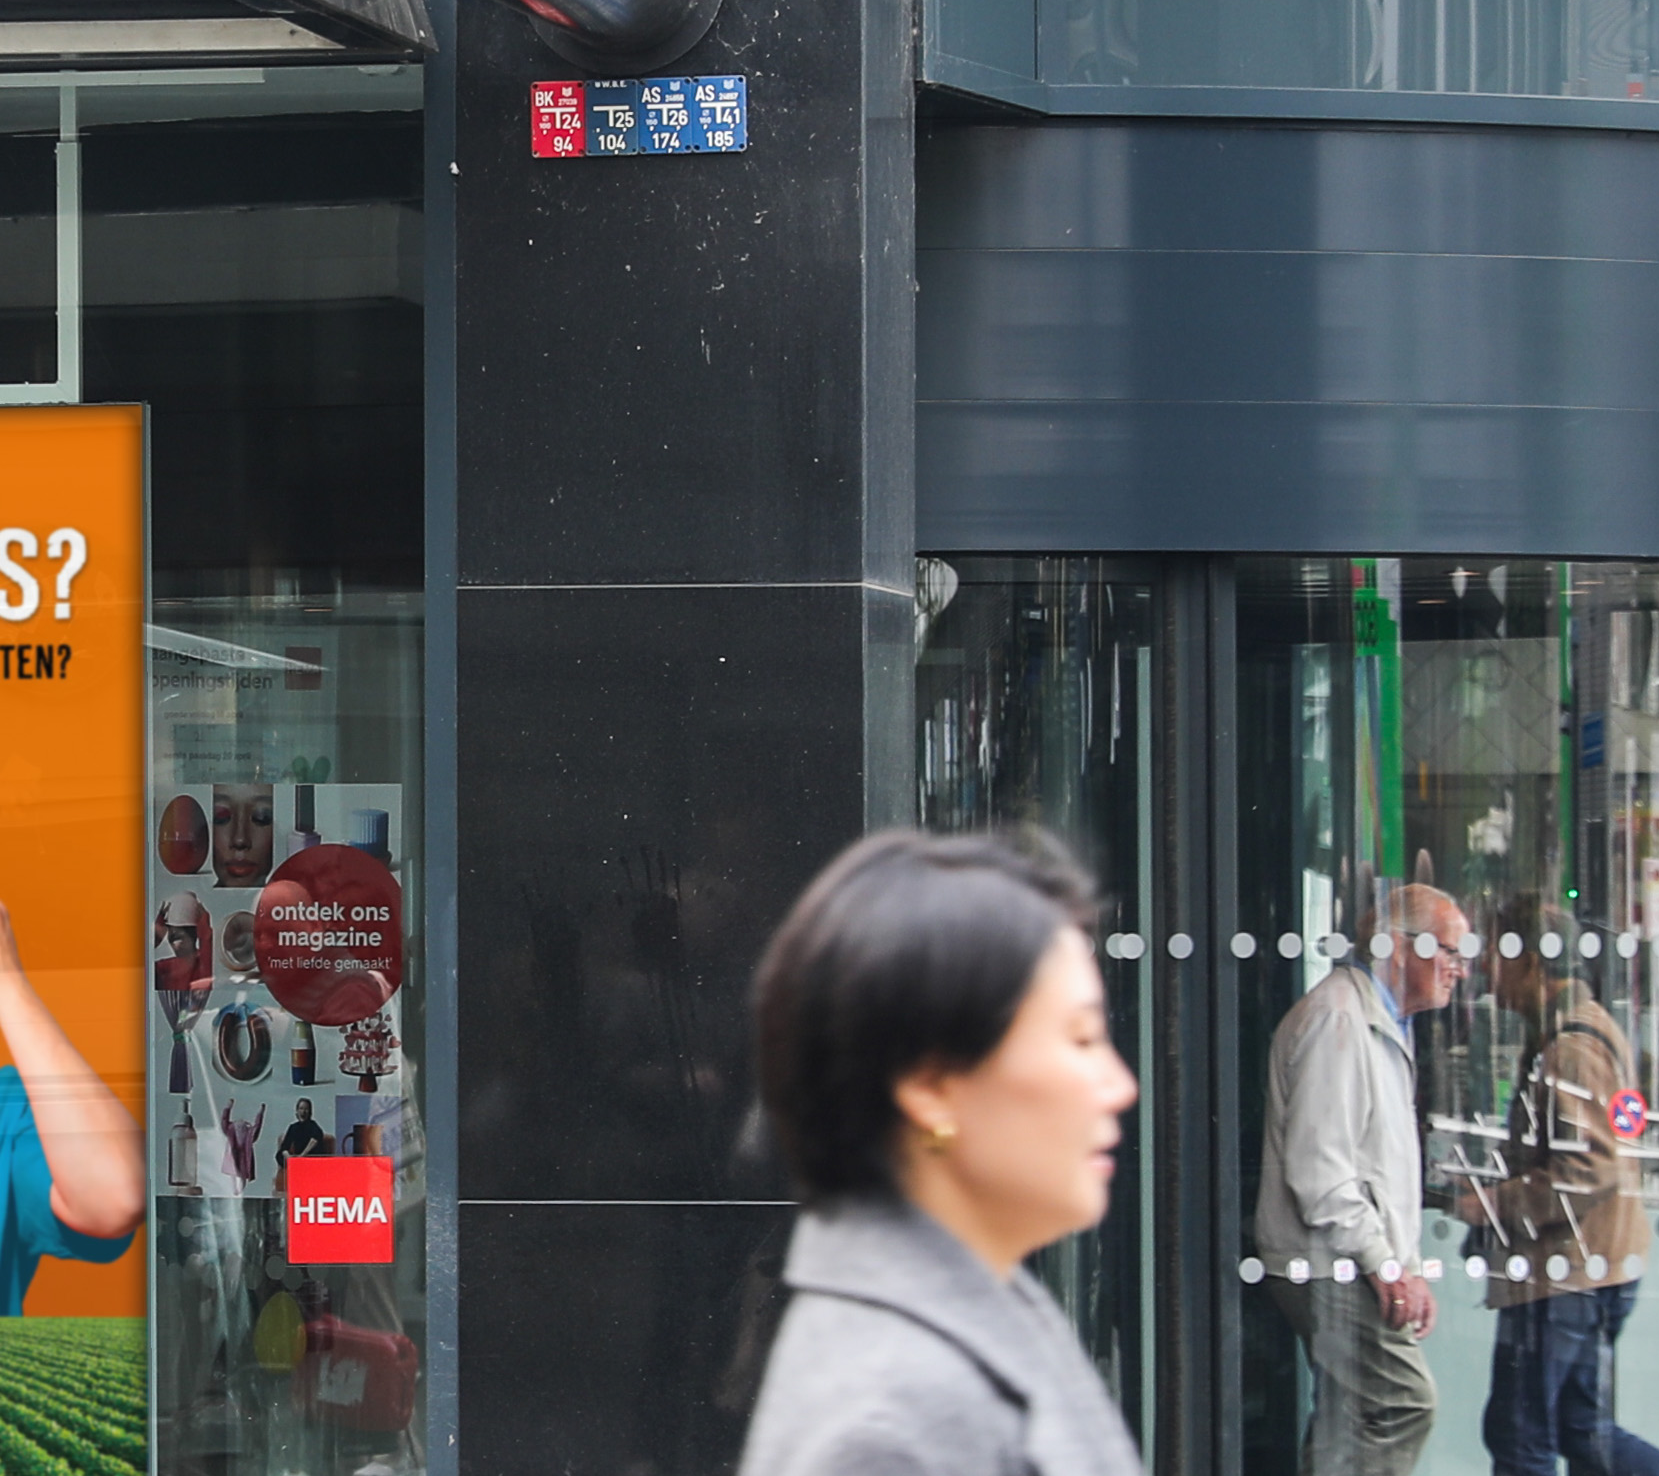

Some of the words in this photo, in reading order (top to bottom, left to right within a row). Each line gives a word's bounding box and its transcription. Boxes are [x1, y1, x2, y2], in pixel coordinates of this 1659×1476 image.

[534, 91, 555, 107] BK
[641, 87, 662, 103] AS
[695, 85, 716, 101] AS
[270, 901, 346, 922] ontdek
[350, 905, 391, 922] ons
[277, 926, 383, 952] magazine
[296, 956, 332, 970] liefde
[293, 1196, 388, 1225] HEMA
